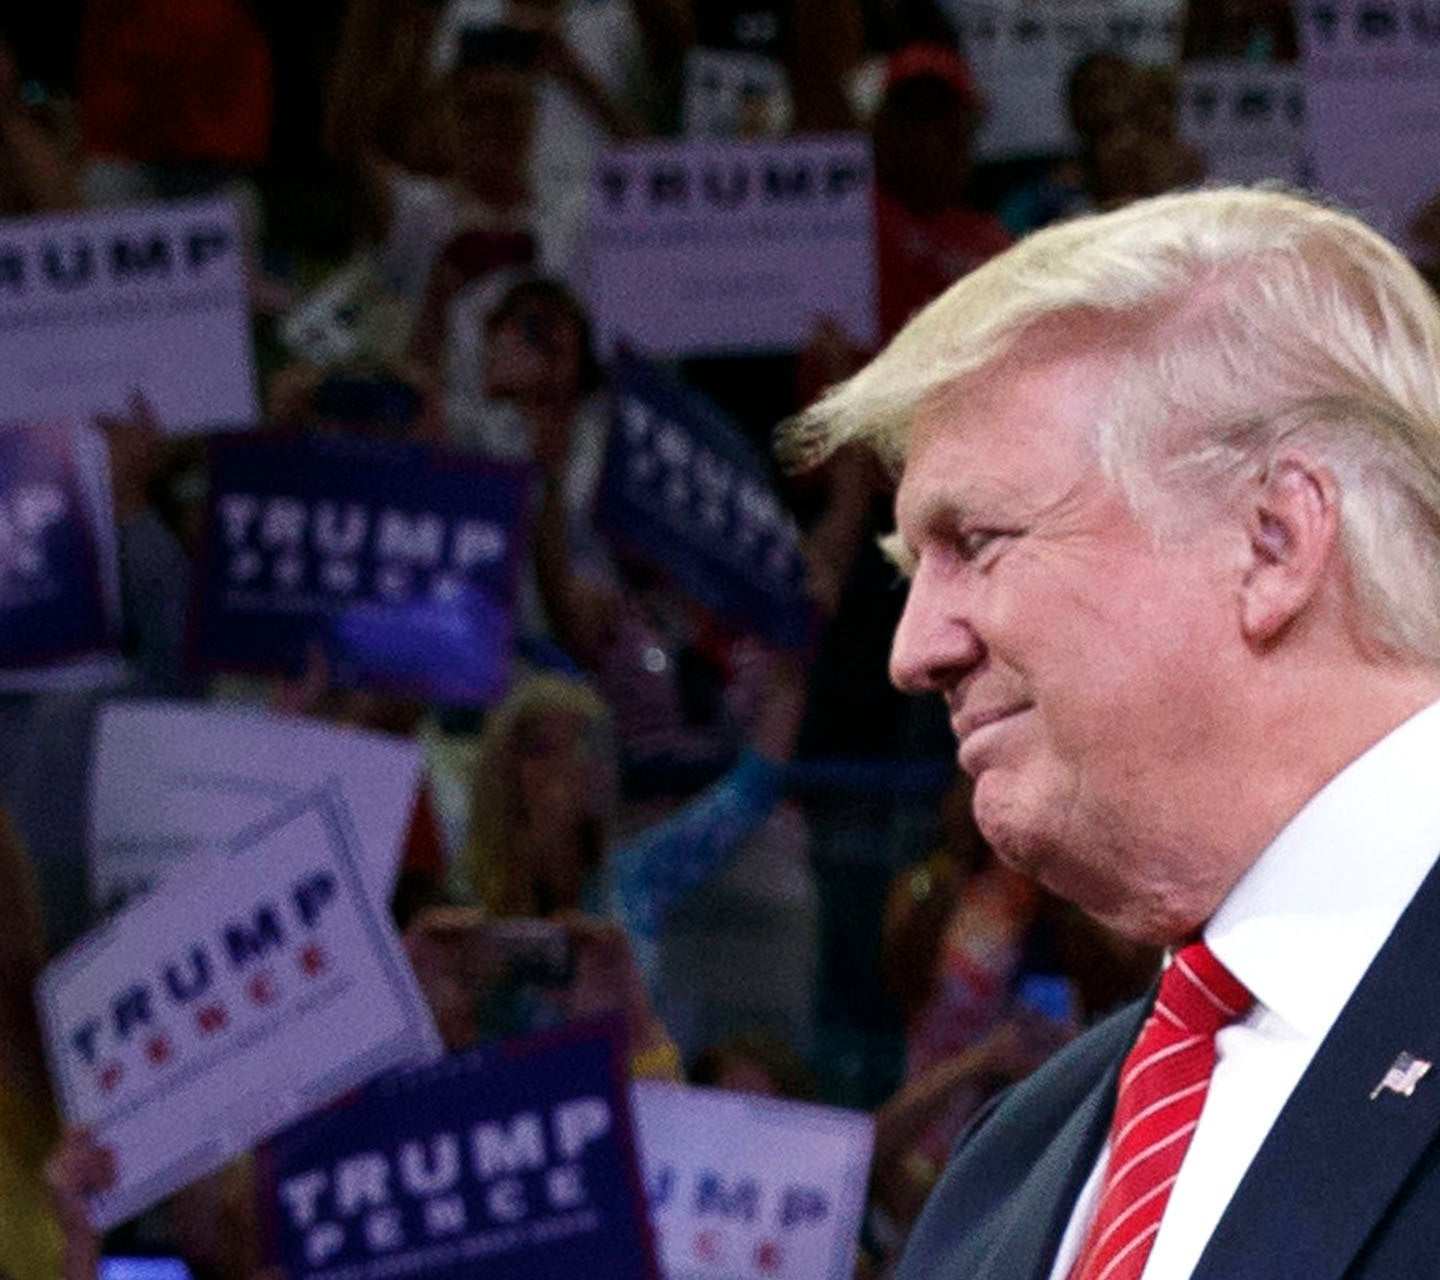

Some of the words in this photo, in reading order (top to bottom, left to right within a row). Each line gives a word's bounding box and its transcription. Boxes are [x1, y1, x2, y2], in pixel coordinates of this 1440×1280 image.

[598, 158, 866, 205] TRUMP
[217, 493, 508, 570] TRUMP
[74, 870, 338, 1068] TRUMP
[278, 1097, 616, 1232] TRUMP
[304, 1163, 589, 1267] PENCE
